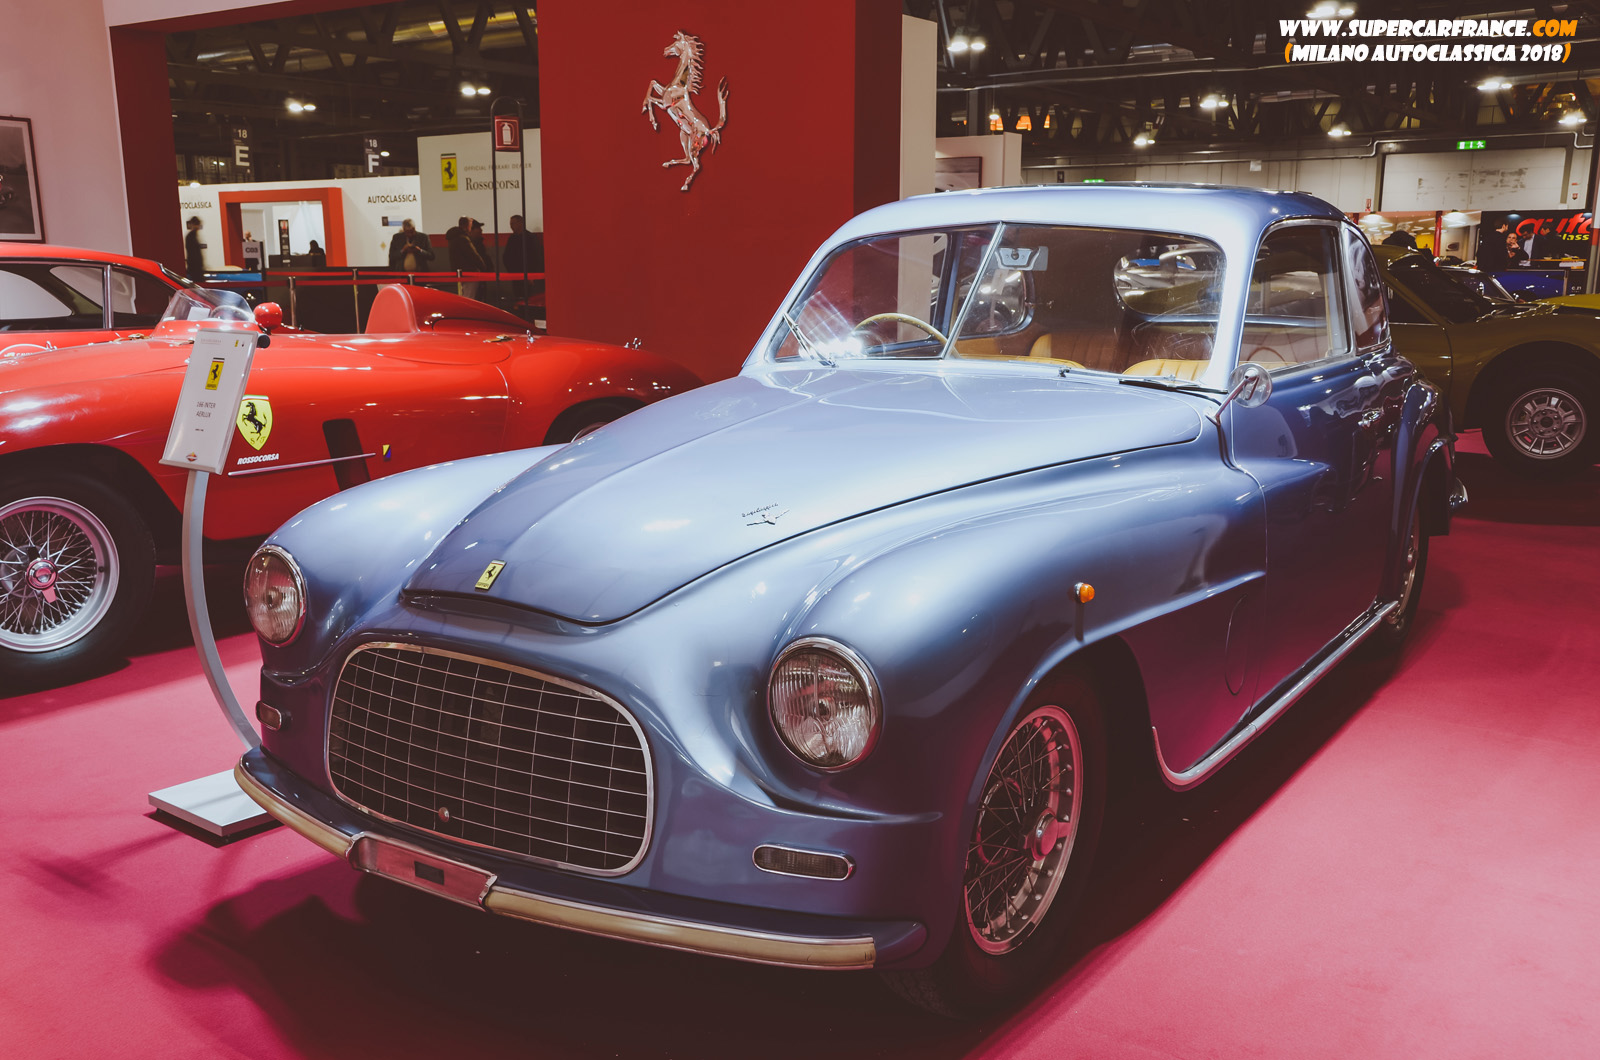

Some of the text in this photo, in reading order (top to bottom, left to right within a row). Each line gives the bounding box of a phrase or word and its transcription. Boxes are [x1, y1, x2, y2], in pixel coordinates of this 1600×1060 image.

[238, 129, 248, 138] 18
[369, 139, 378, 148] 18
[235, 145, 250, 166] E
[367, 154, 380, 173] F
[367, 194, 417, 204] AUTOCLASSICA
[180, 201, 212, 209] TOCLASSICA
[1557, 233, 1590, 241] lass
[236, 453, 280, 466] ROSSOCORSA
